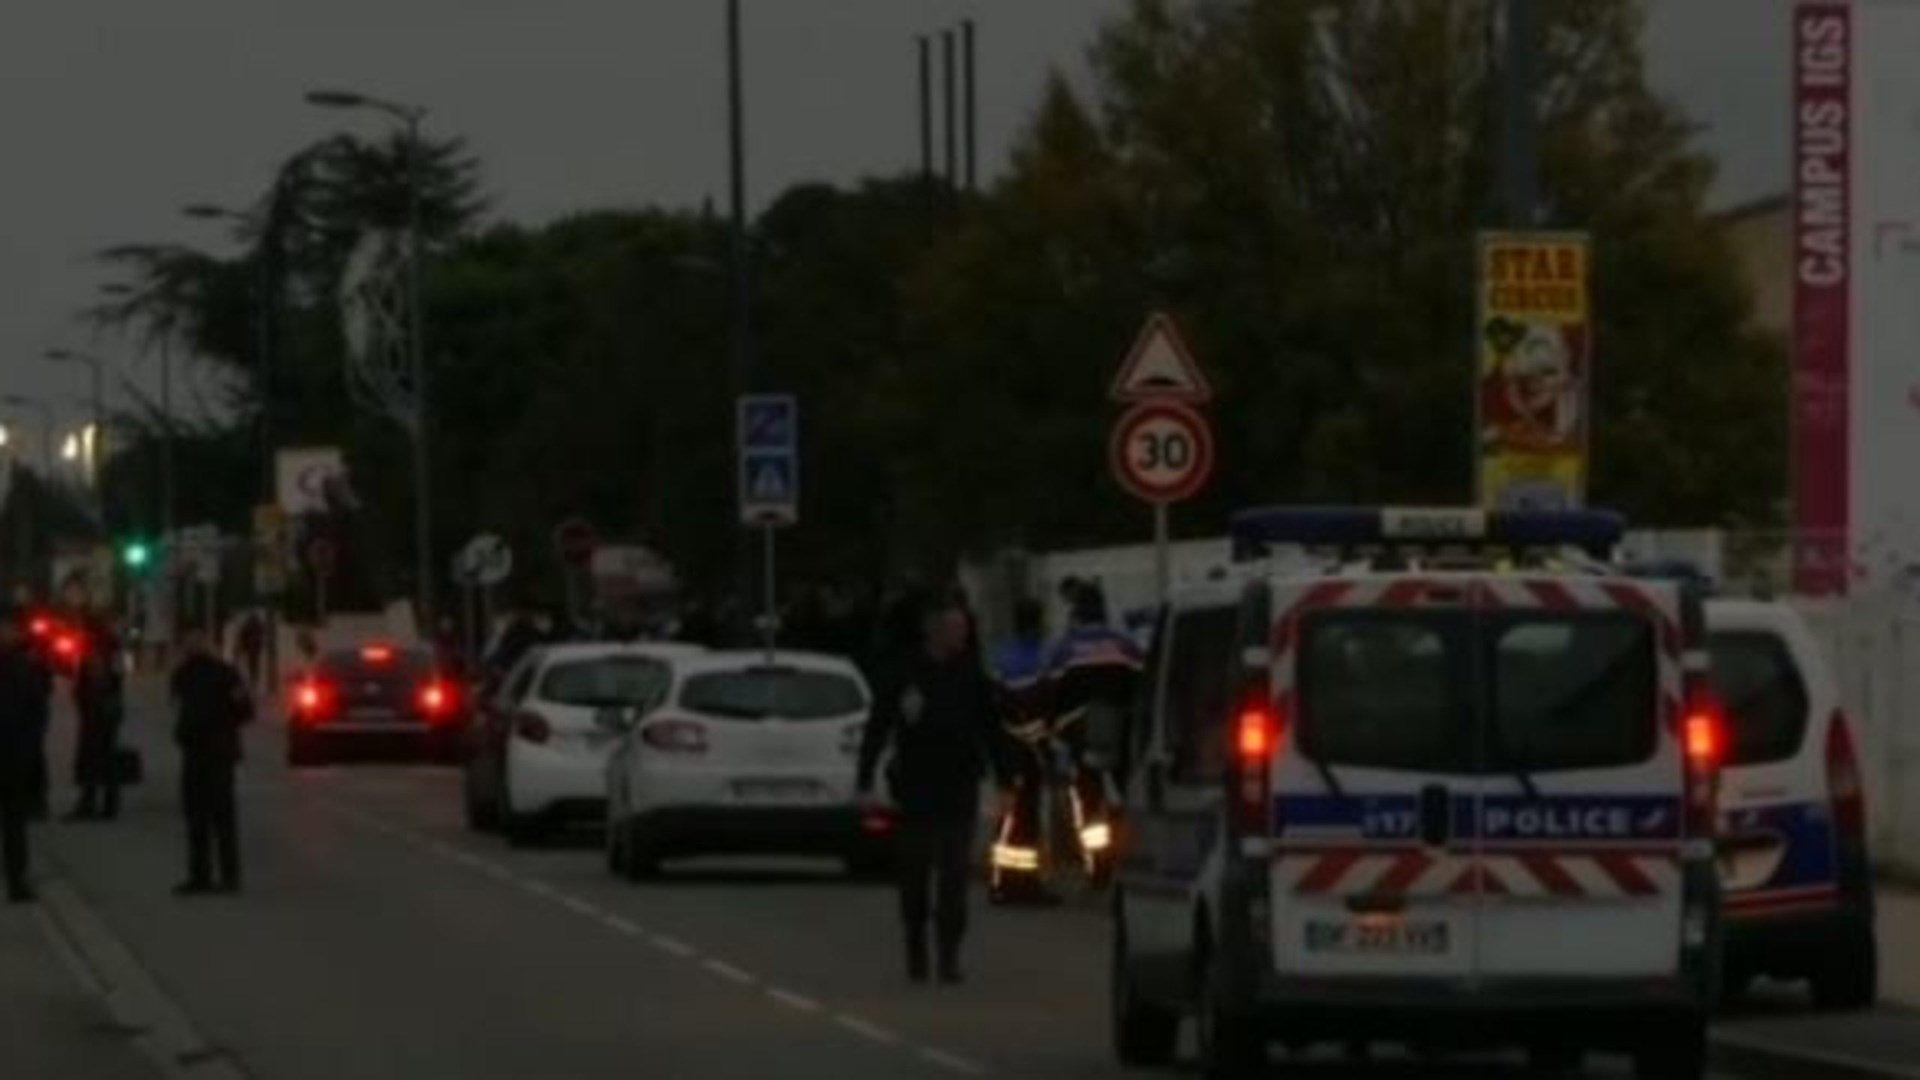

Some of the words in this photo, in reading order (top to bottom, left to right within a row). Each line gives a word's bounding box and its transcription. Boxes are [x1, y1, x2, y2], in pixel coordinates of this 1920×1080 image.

[1800, 17, 1844, 86] IGS
[1800, 101, 1844, 287] CAMPUS
[1492, 249, 1576, 279] STAR
[1139, 433, 1188, 469] 30
[1486, 810, 1631, 833] POLICE
